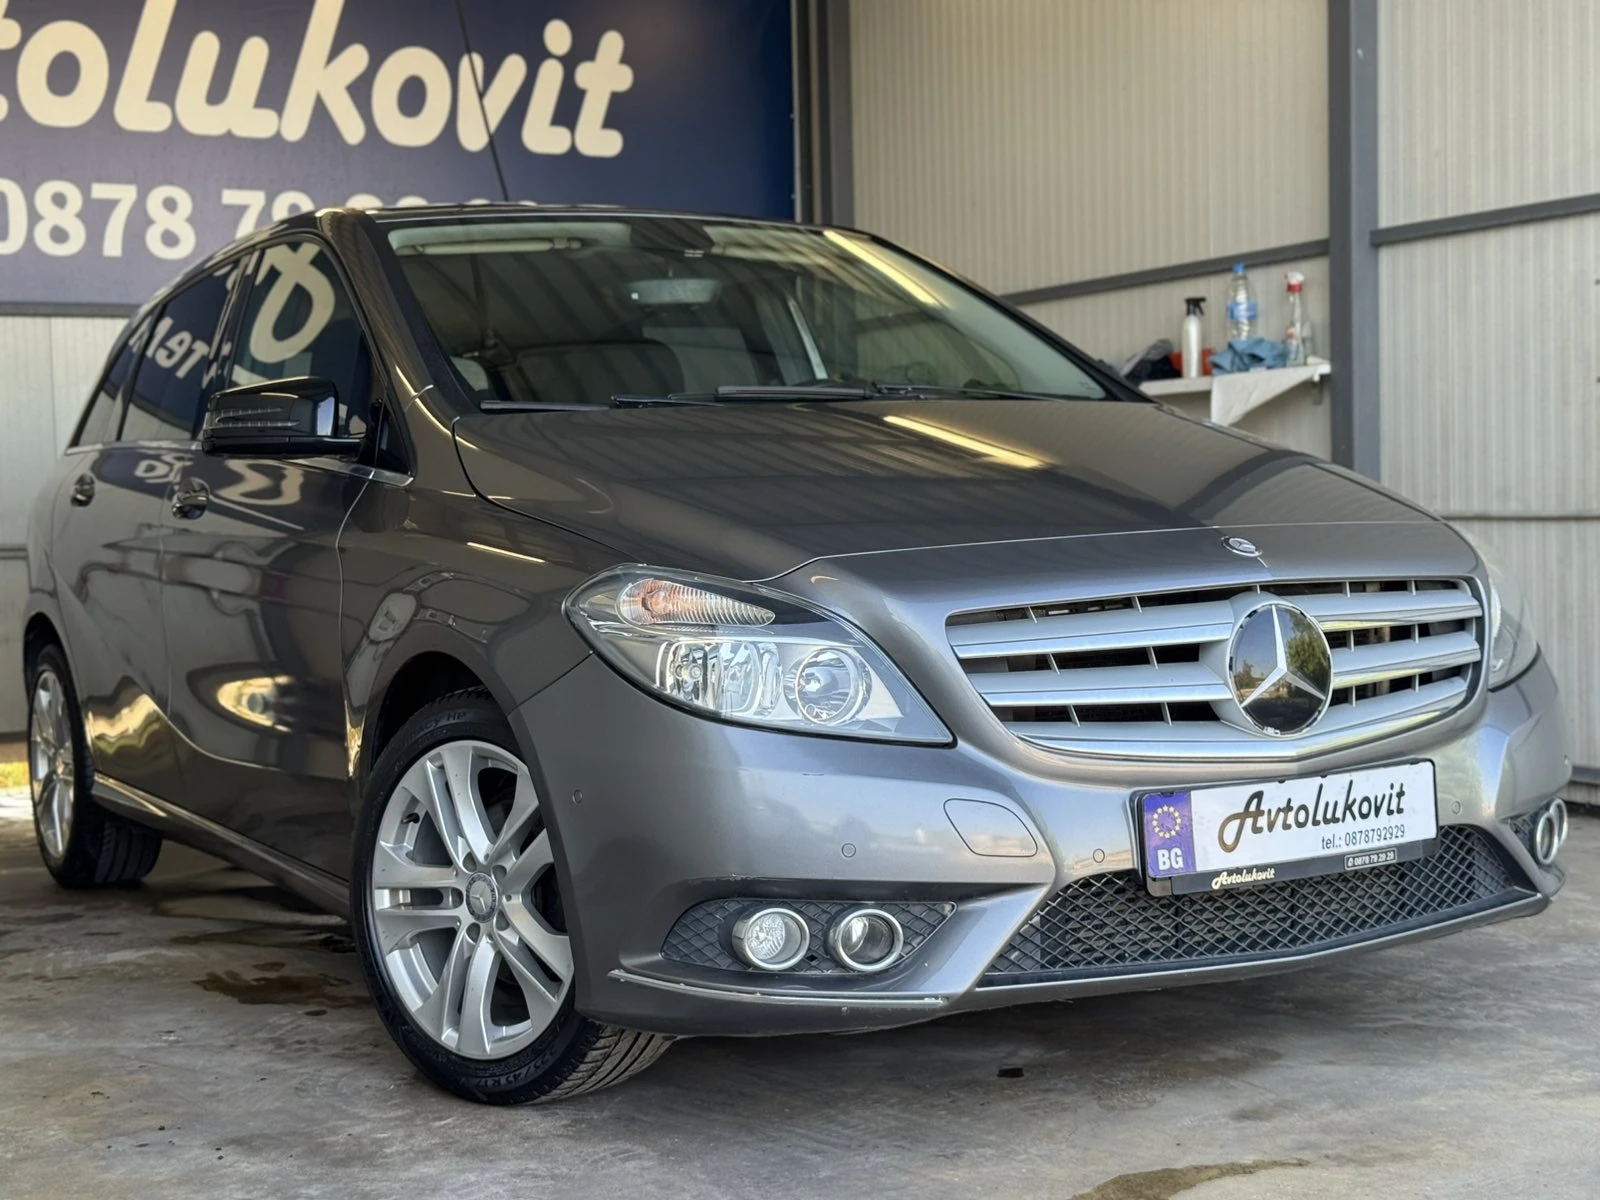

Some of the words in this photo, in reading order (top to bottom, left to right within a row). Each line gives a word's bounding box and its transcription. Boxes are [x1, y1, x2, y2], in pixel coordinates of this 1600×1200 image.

[1218, 780, 1406, 852] Avtolukovit
[1344, 824, 1405, 847] 0878792929
[1157, 848, 1184, 871] BG
[1211, 867, 1276, 890] Avtolukovit
